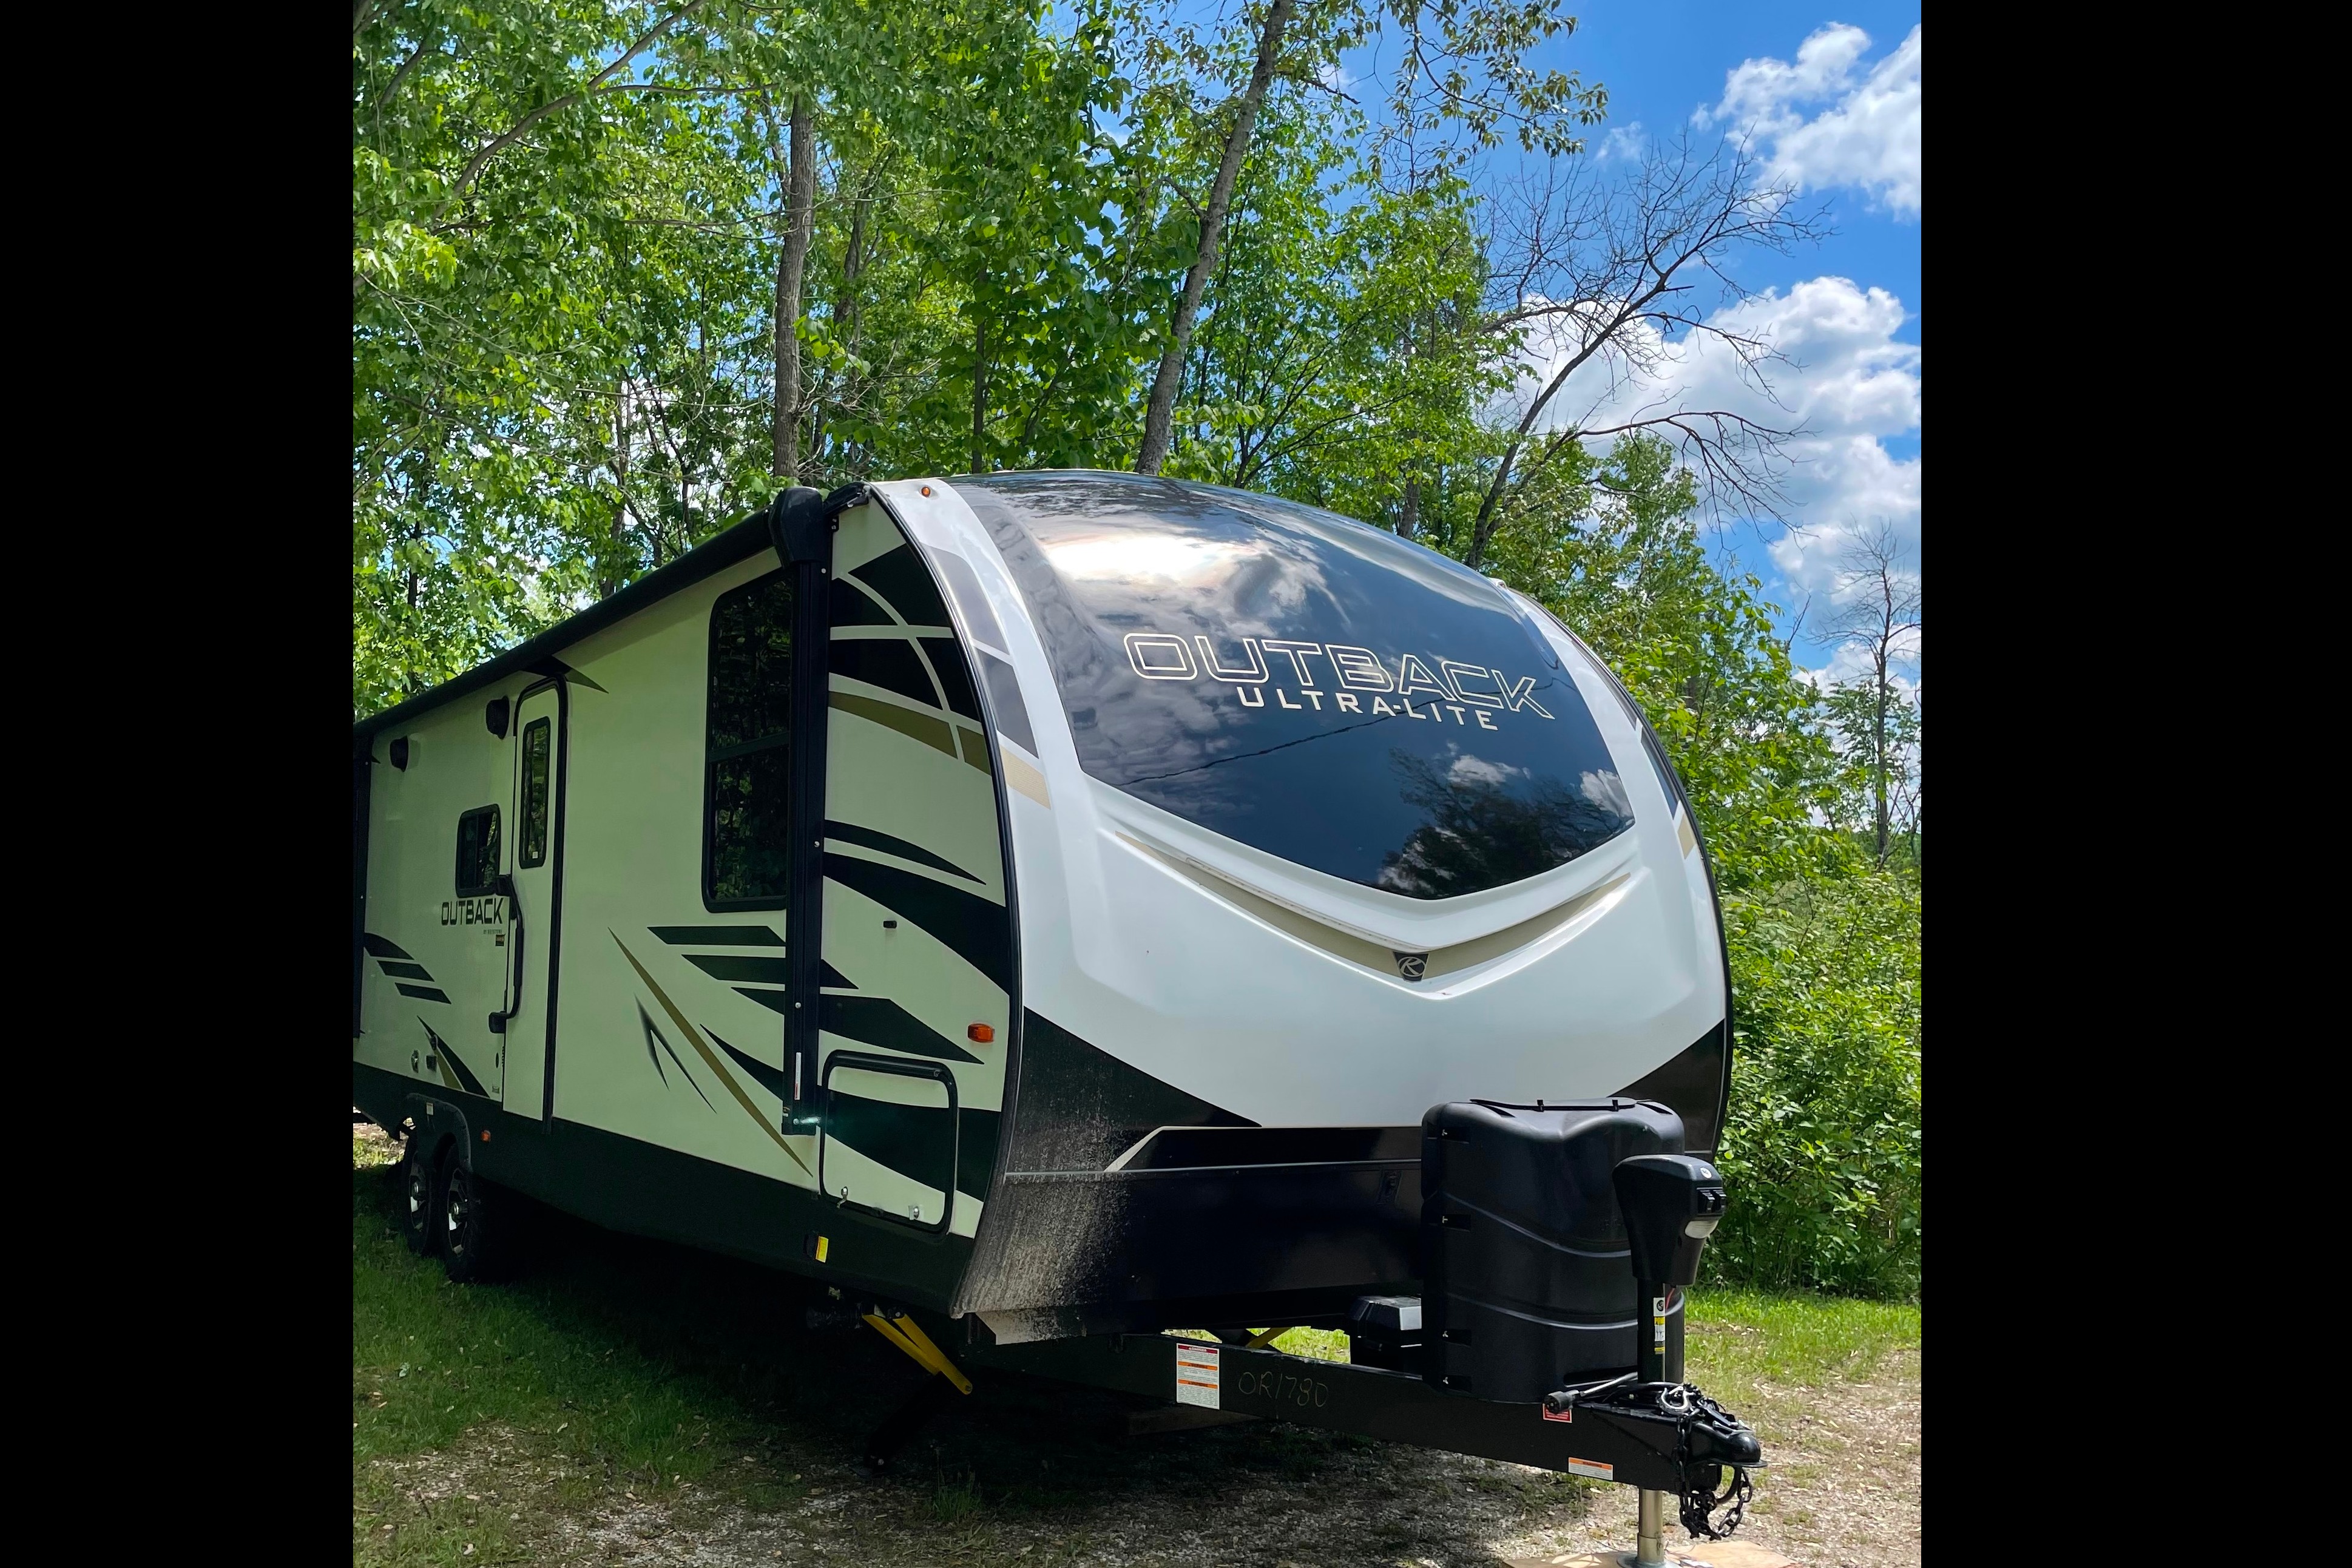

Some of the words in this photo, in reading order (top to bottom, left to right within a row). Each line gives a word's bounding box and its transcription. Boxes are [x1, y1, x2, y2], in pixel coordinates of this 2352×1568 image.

[1123, 632, 1555, 720] OUTBACK
[1236, 686, 1499, 731] ULTRA-LITE
[441, 897, 504, 926] OUTBACK
